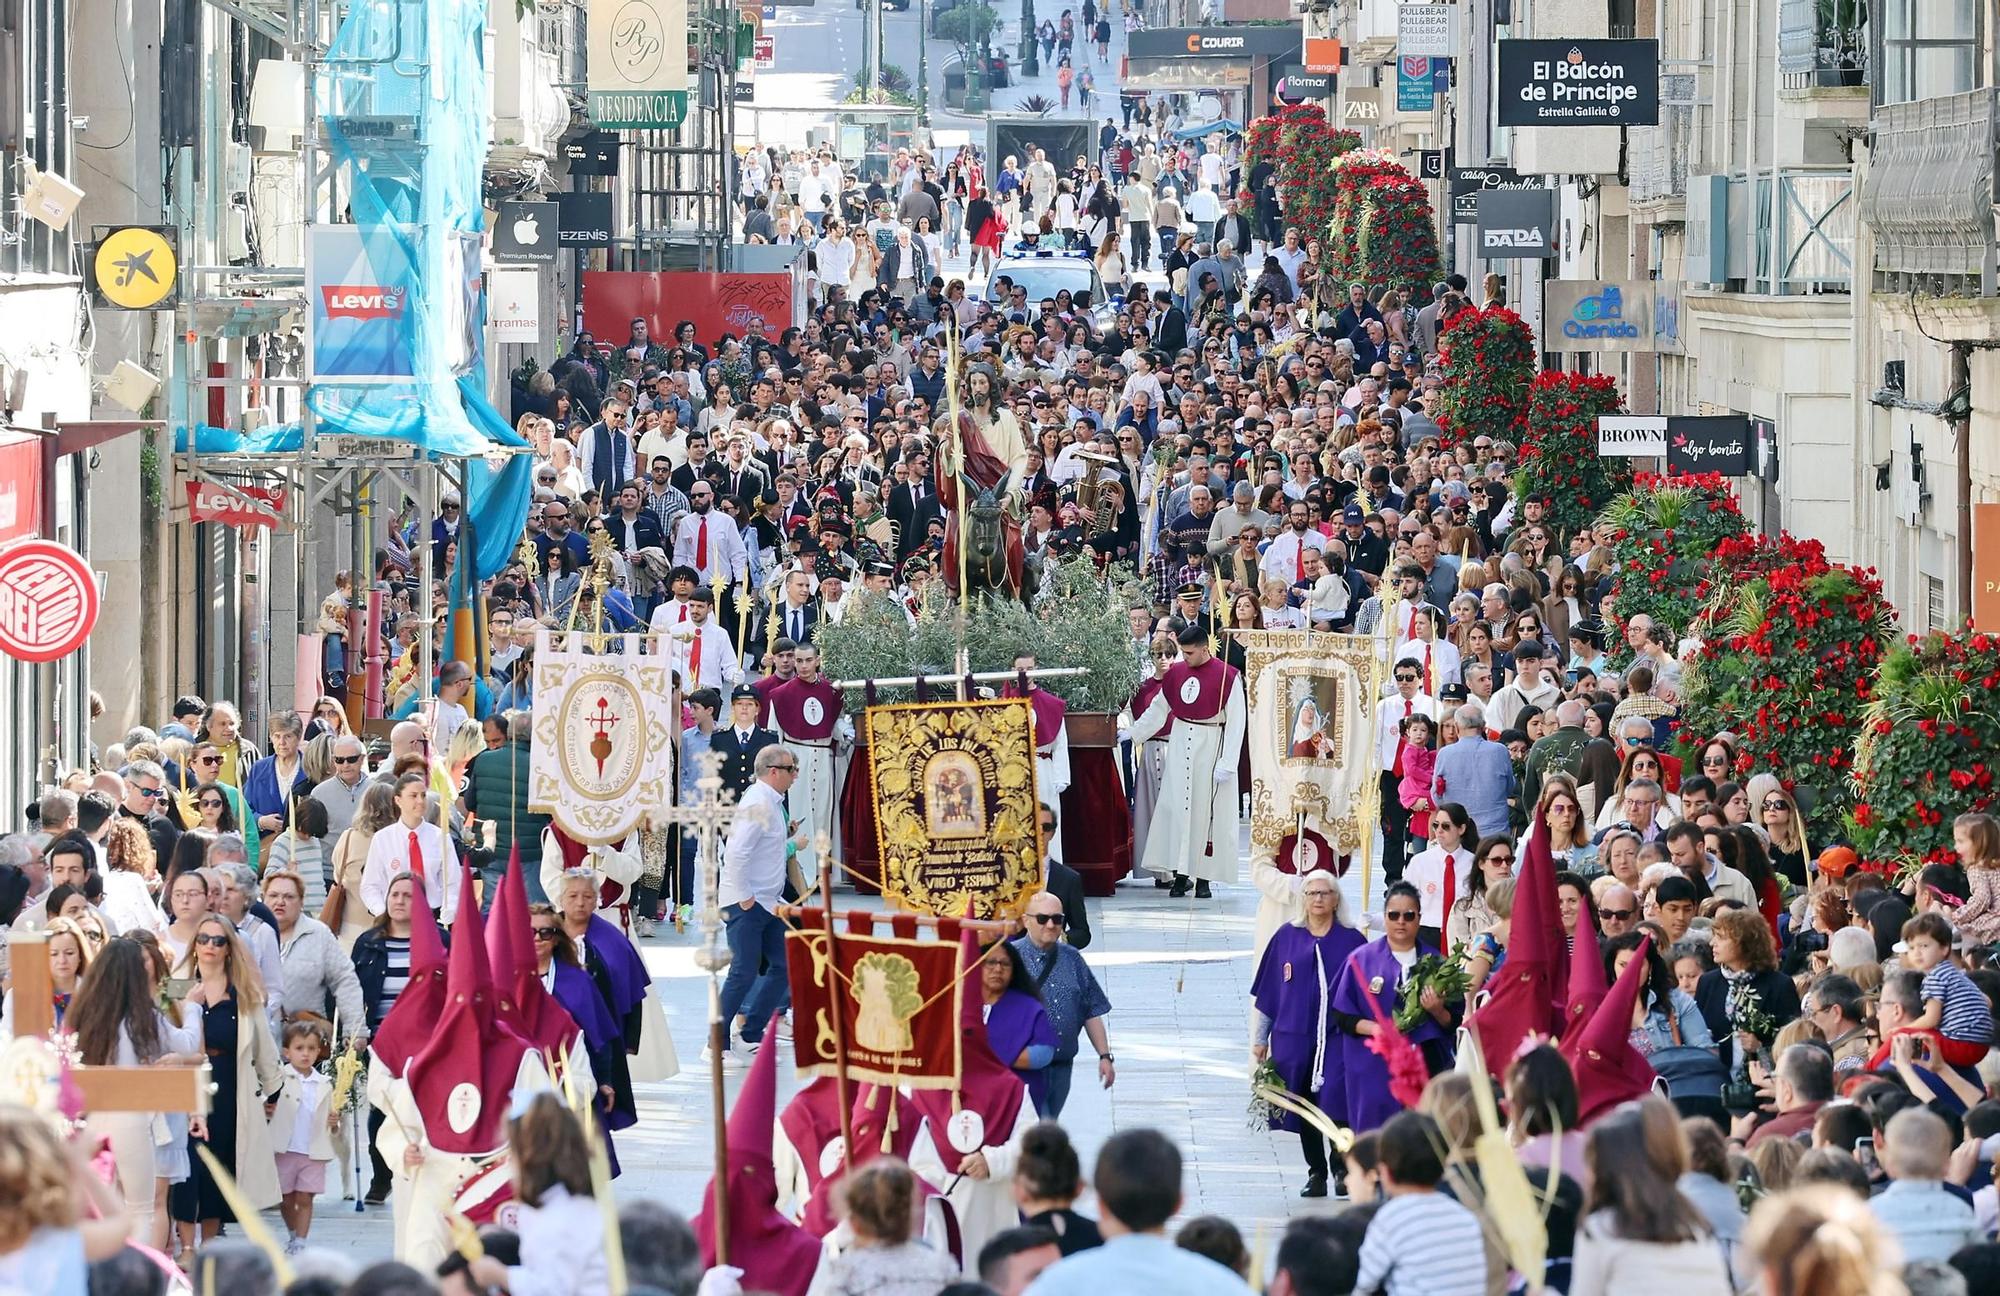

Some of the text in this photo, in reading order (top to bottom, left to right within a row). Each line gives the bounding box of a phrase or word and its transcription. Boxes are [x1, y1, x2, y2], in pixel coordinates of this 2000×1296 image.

[1400, 17, 1447, 25] PULL&BEAR
[1202, 37, 1244, 48] COURIR
[1307, 64, 1337, 72] orange
[1533, 61, 1624, 80] El Balcón
[1288, 75, 1327, 87] flormar
[1520, 82, 1638, 104] de Príncipe
[597, 95, 678, 123] RESIDENCIA
[1345, 101, 1379, 119] ZARA
[1538, 106, 1607, 117] Estrella Galicia
[1460, 170, 1487, 180] casa
[1484, 226, 1544, 247] DADÁ
[1681, 439, 1743, 461] algo bonito
[938, 737, 959, 750] LOS
[925, 876, 956, 889] VIGO
